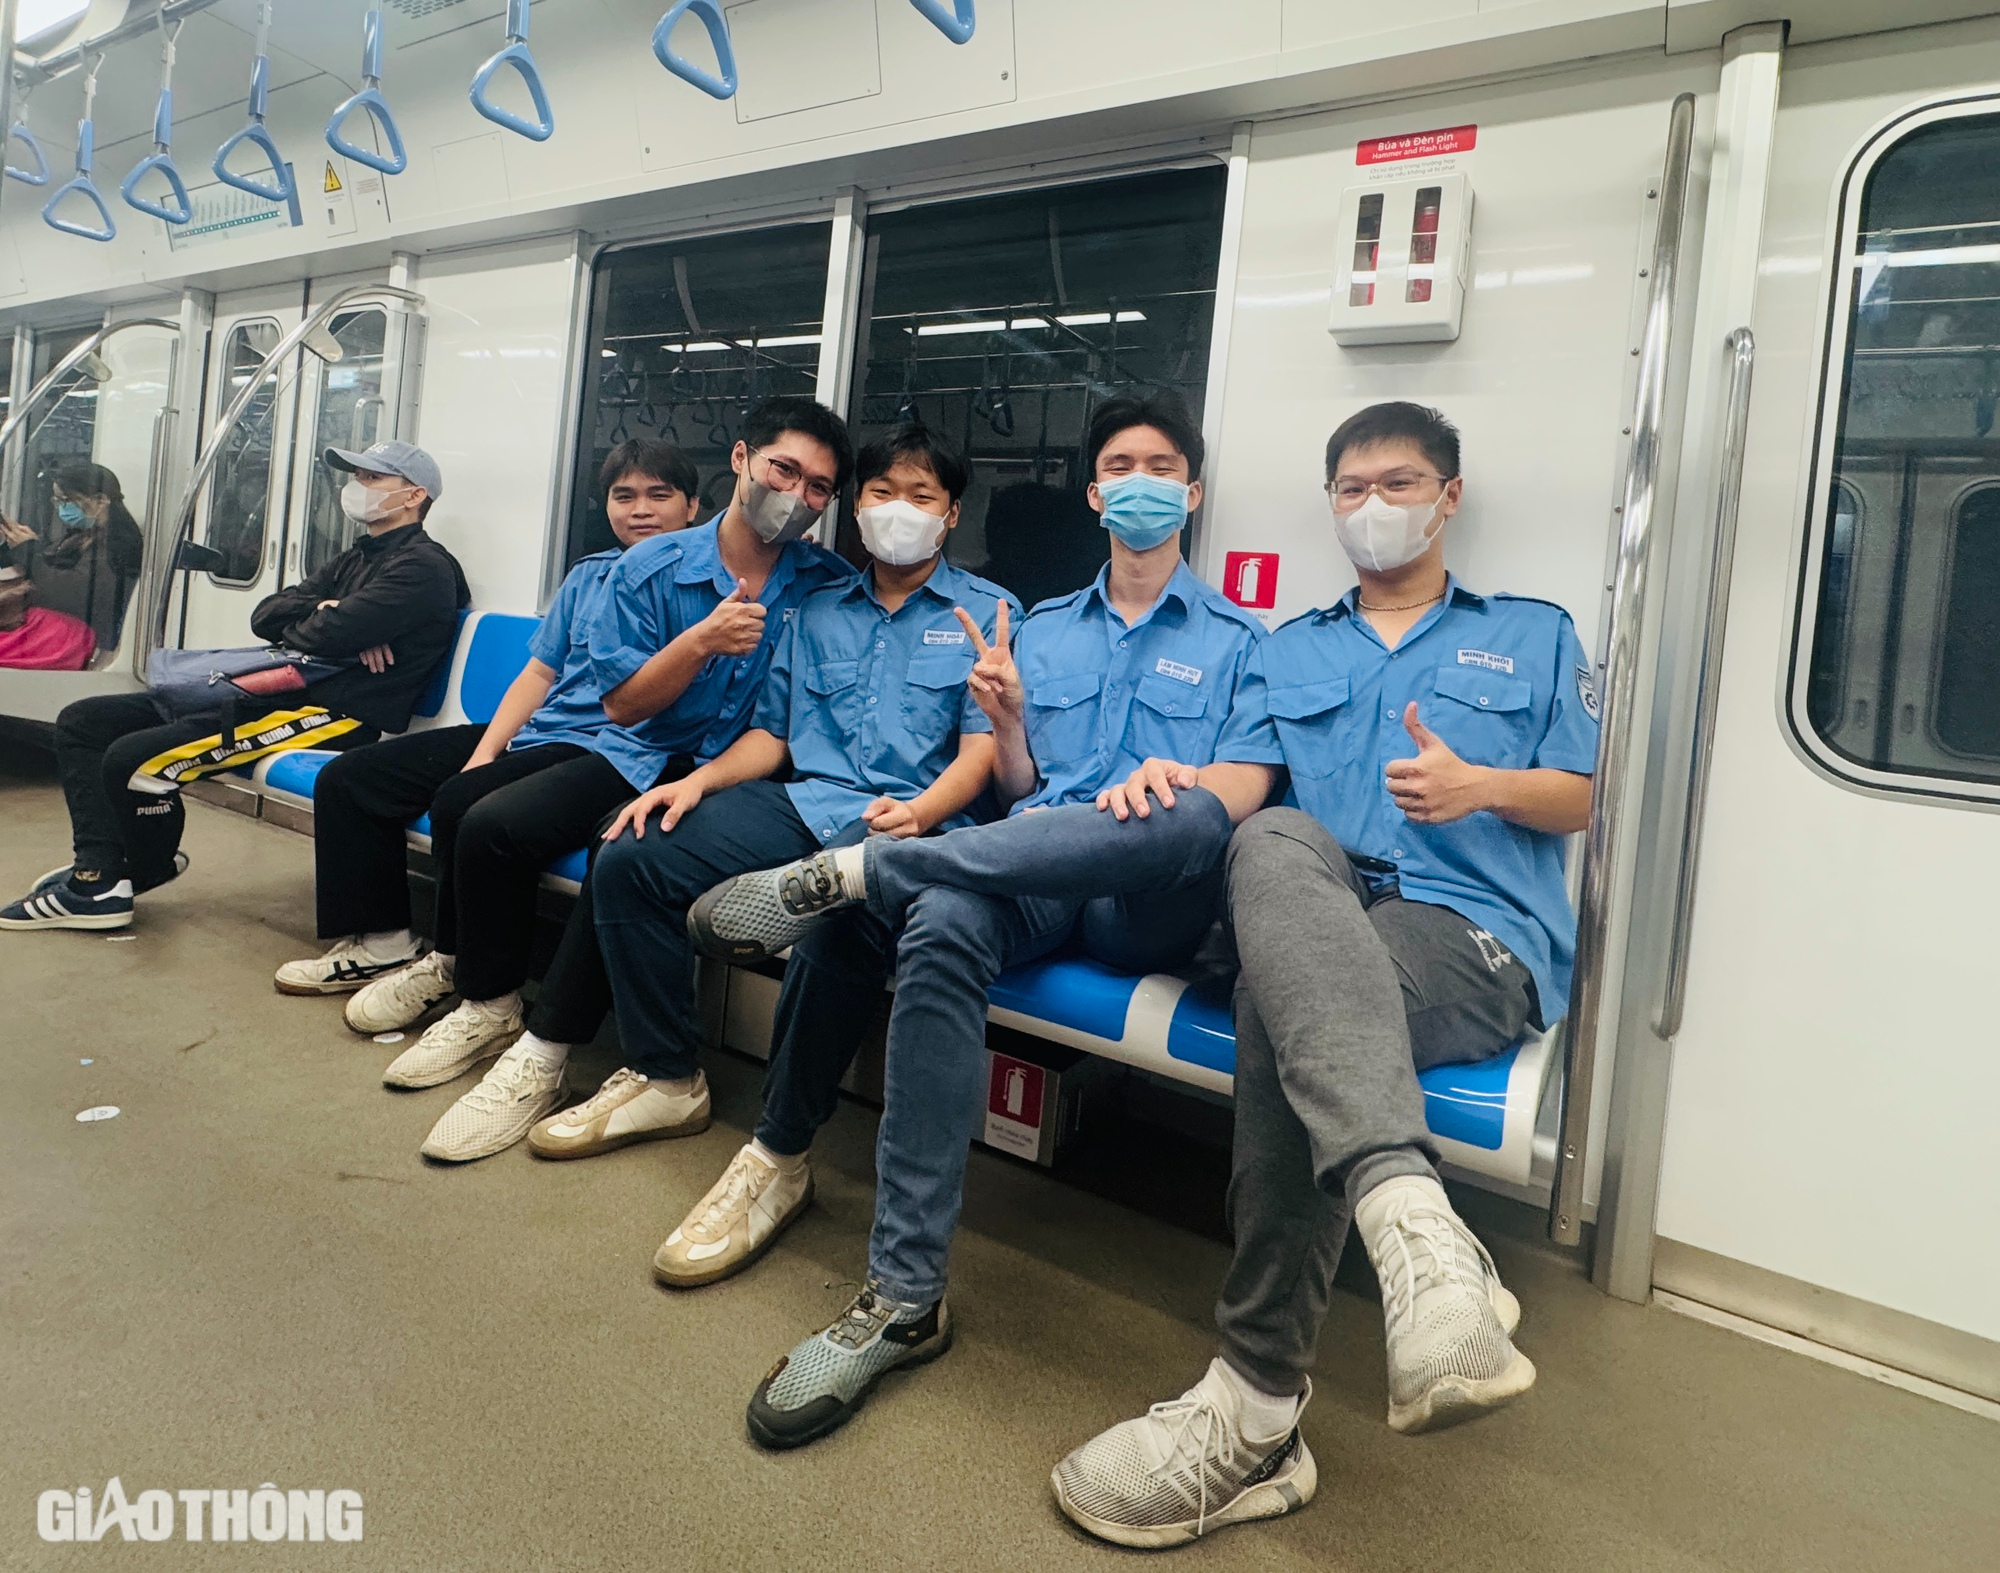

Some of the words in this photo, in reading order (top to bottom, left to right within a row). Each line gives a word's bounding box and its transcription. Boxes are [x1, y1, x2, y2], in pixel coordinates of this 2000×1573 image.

[1372, 151, 1402, 160] Hammer
[1403, 147, 1418, 156] and
[1419, 144, 1437, 153] Flash
[1438, 142, 1458, 151] Light
[1378, 142, 1397, 151] Búa
[1400, 139, 1411, 147] và
[1413, 136, 1434, 146] Đèn
[1436, 133, 1454, 144] pin
[1461, 651, 1485, 660] MINH
